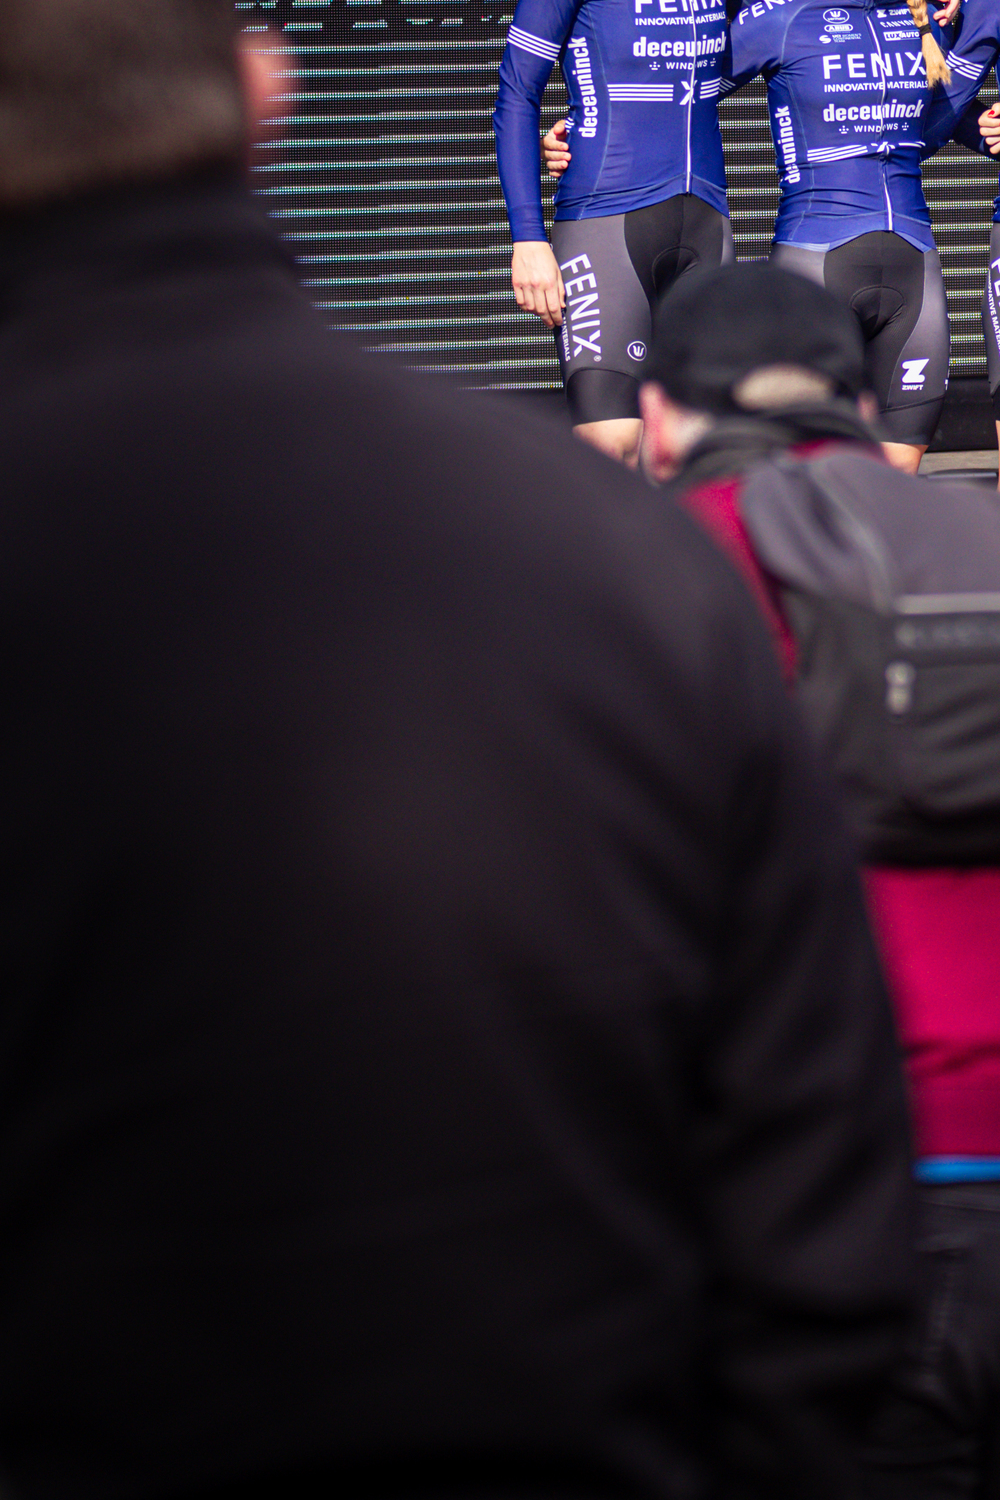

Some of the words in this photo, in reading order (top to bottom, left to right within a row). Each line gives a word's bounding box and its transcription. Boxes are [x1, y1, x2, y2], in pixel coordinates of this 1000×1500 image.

[634, 17, 694, 26] INNOVATIVE
[632, 31, 727, 58] deceuninck
[665, 59, 709, 71] WINDWS
[822, 51, 928, 80] FENIX
[567, 36, 599, 138] deceuninck
[824, 82, 884, 93] INNOVATIVE
[887, 80, 929, 90] MATERIALS
[822, 98, 925, 123] deceuninck
[774, 105, 801, 184] duninck
[560, 253, 602, 358] FENIX
